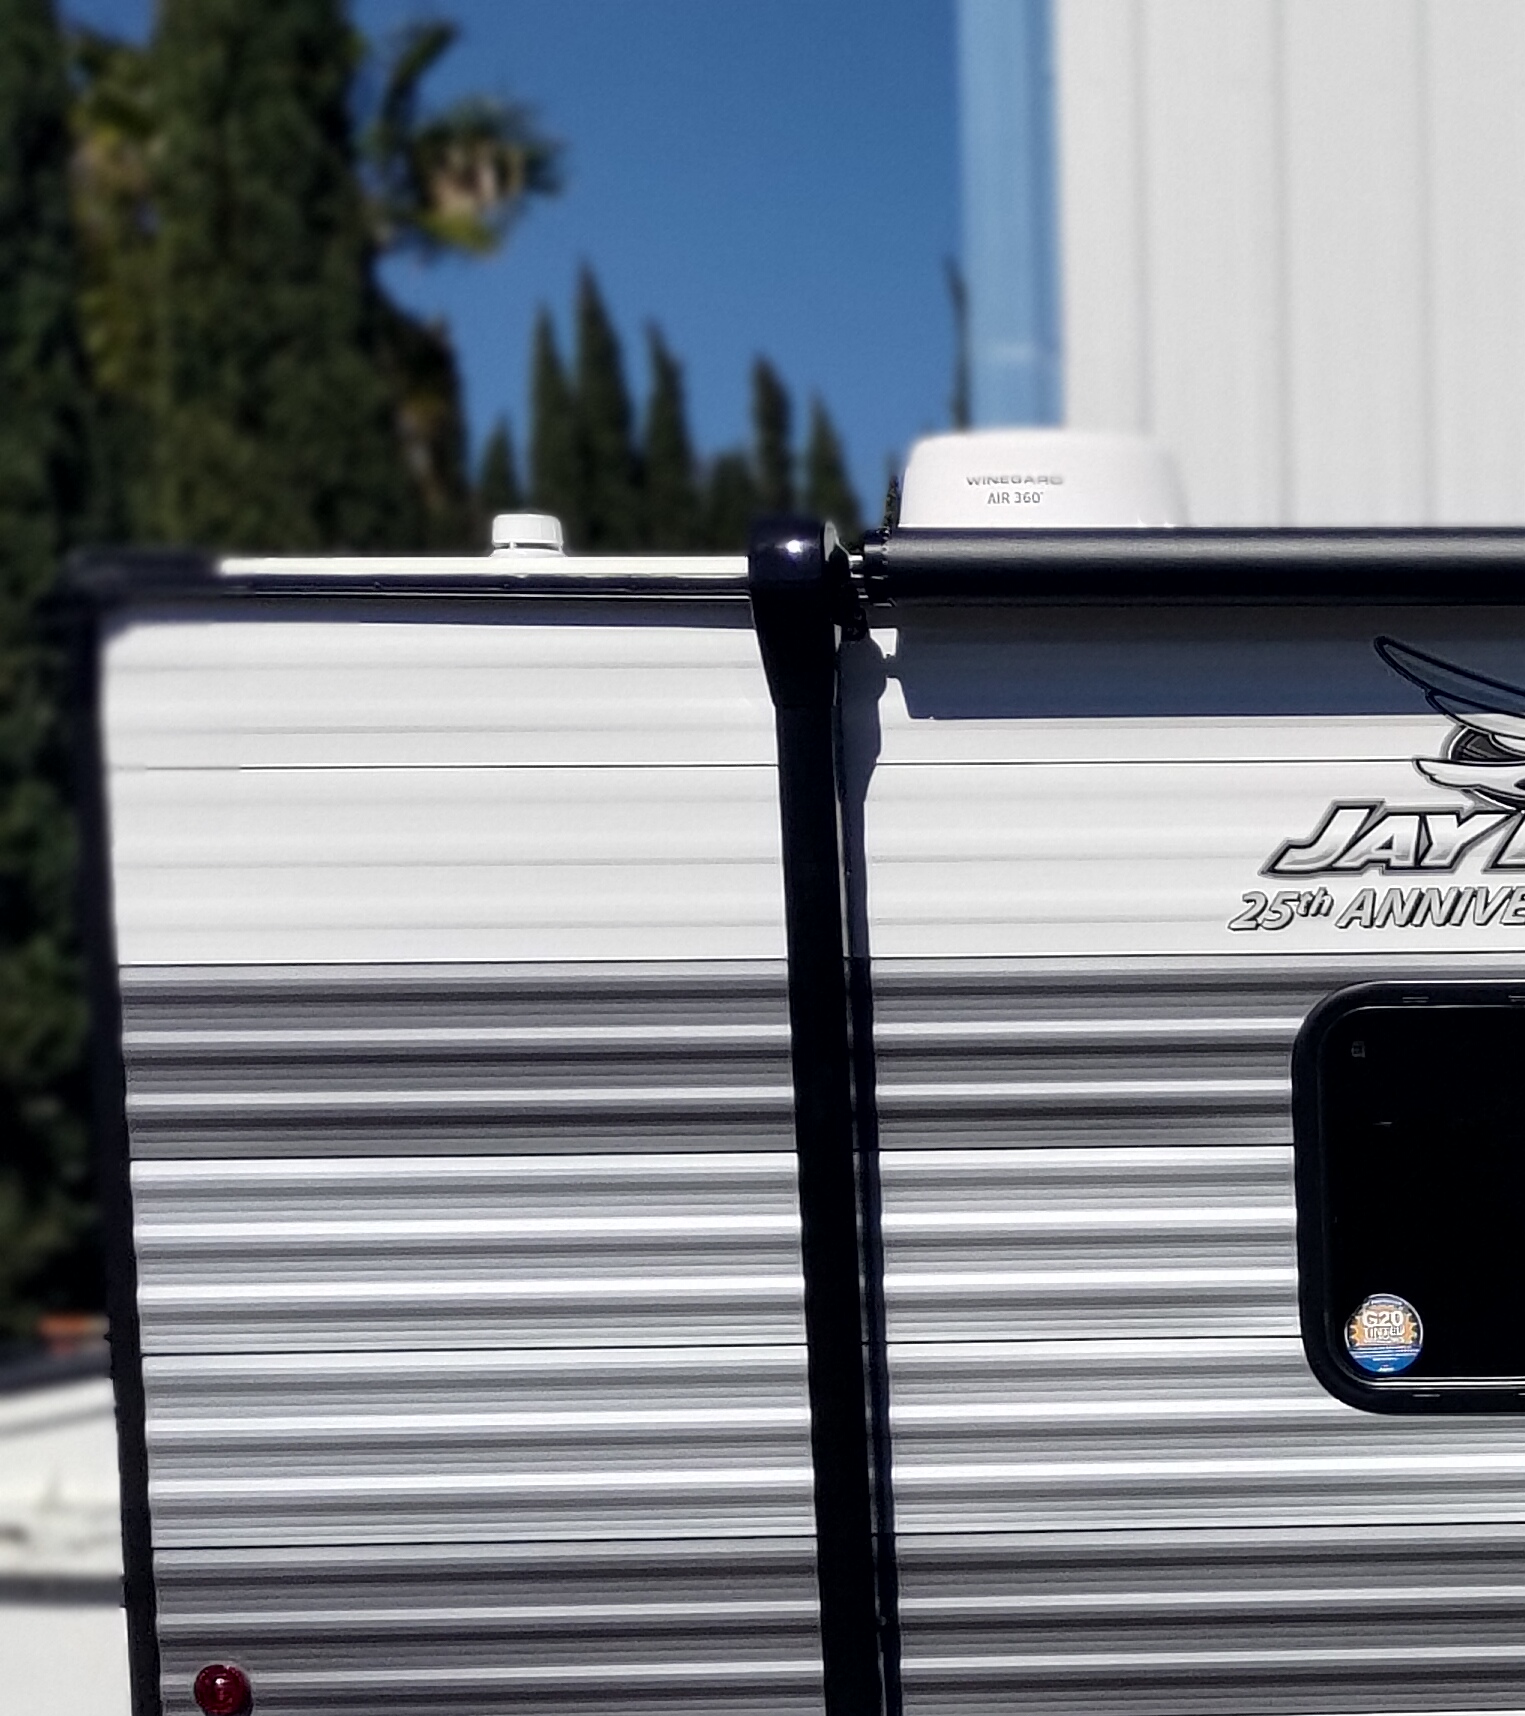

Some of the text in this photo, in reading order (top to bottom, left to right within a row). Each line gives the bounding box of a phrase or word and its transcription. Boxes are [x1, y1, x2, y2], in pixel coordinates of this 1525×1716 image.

[966, 475, 1065, 486] WINEGARD
[987, 492, 1010, 505] AIR
[1261, 800, 1510, 877] JAY
[1227, 889, 1333, 931] 25th
